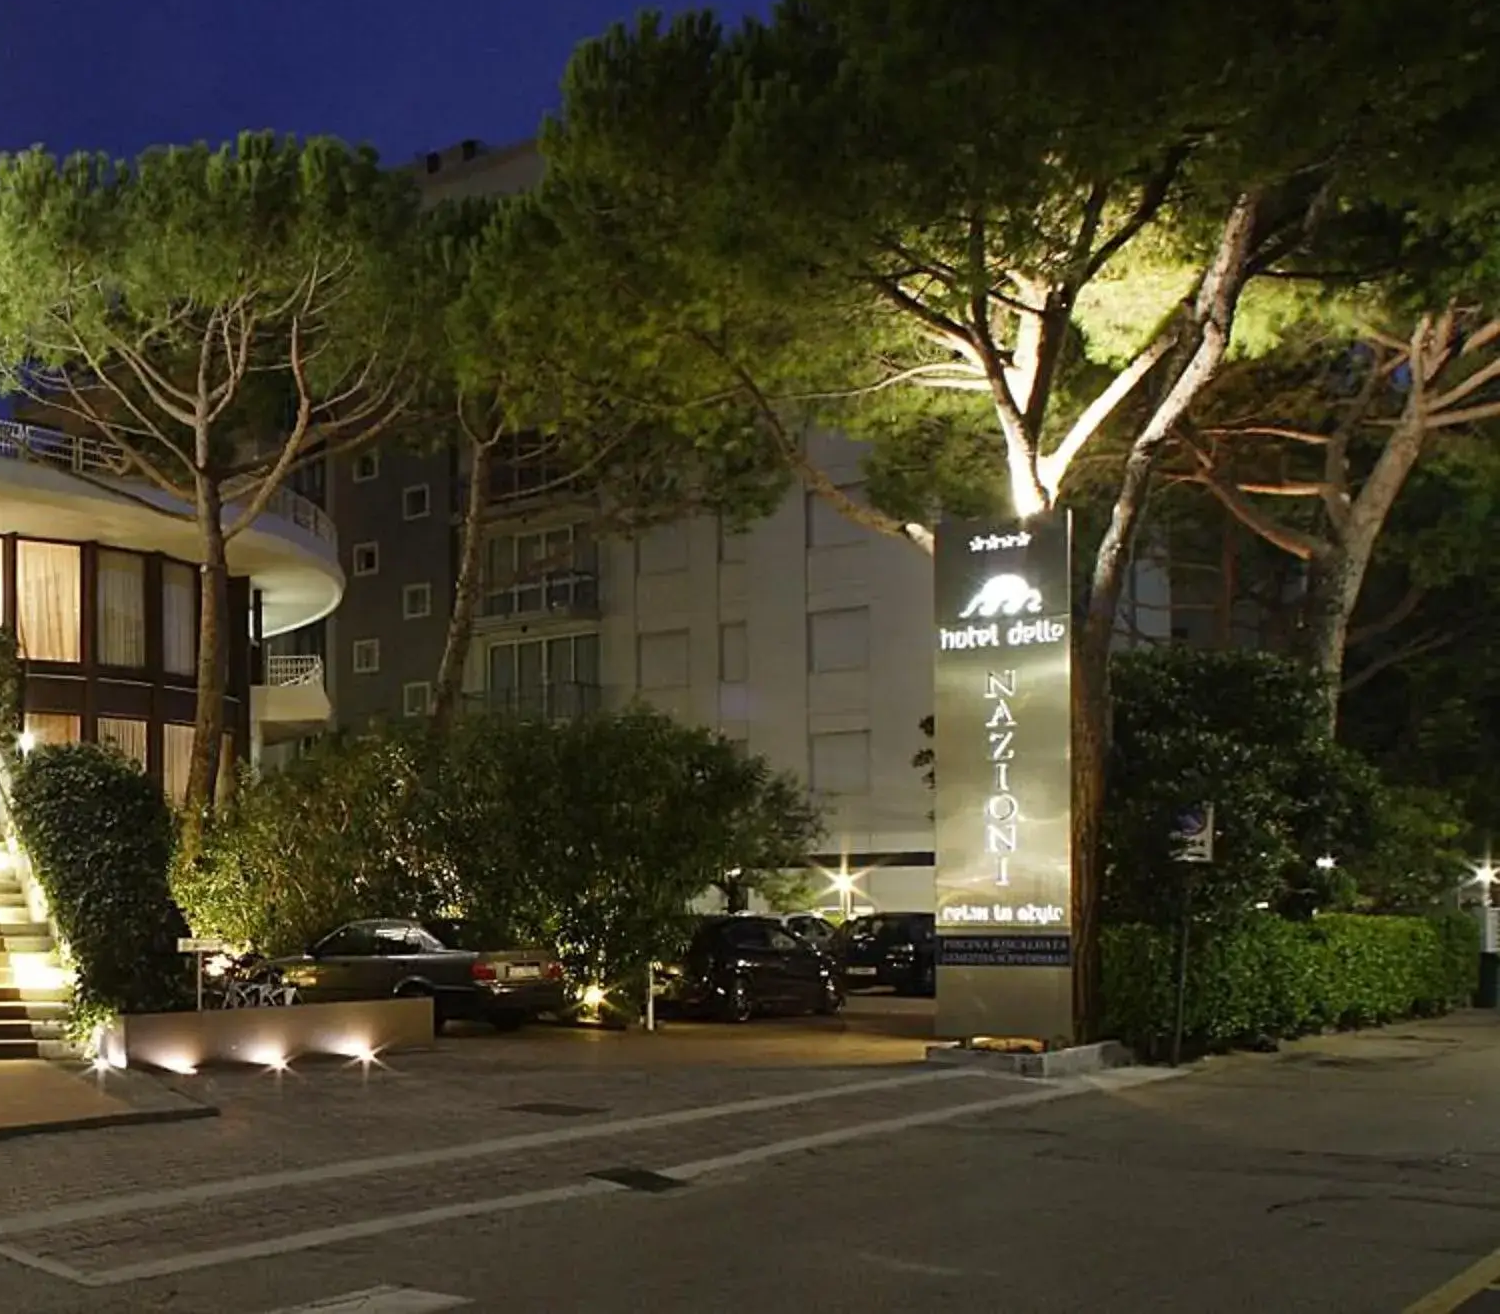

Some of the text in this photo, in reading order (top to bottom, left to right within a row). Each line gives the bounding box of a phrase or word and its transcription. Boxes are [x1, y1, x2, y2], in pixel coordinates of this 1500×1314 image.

[940, 620, 1065, 650] hotel delle
[984, 669, 1019, 886] NAZIONI
